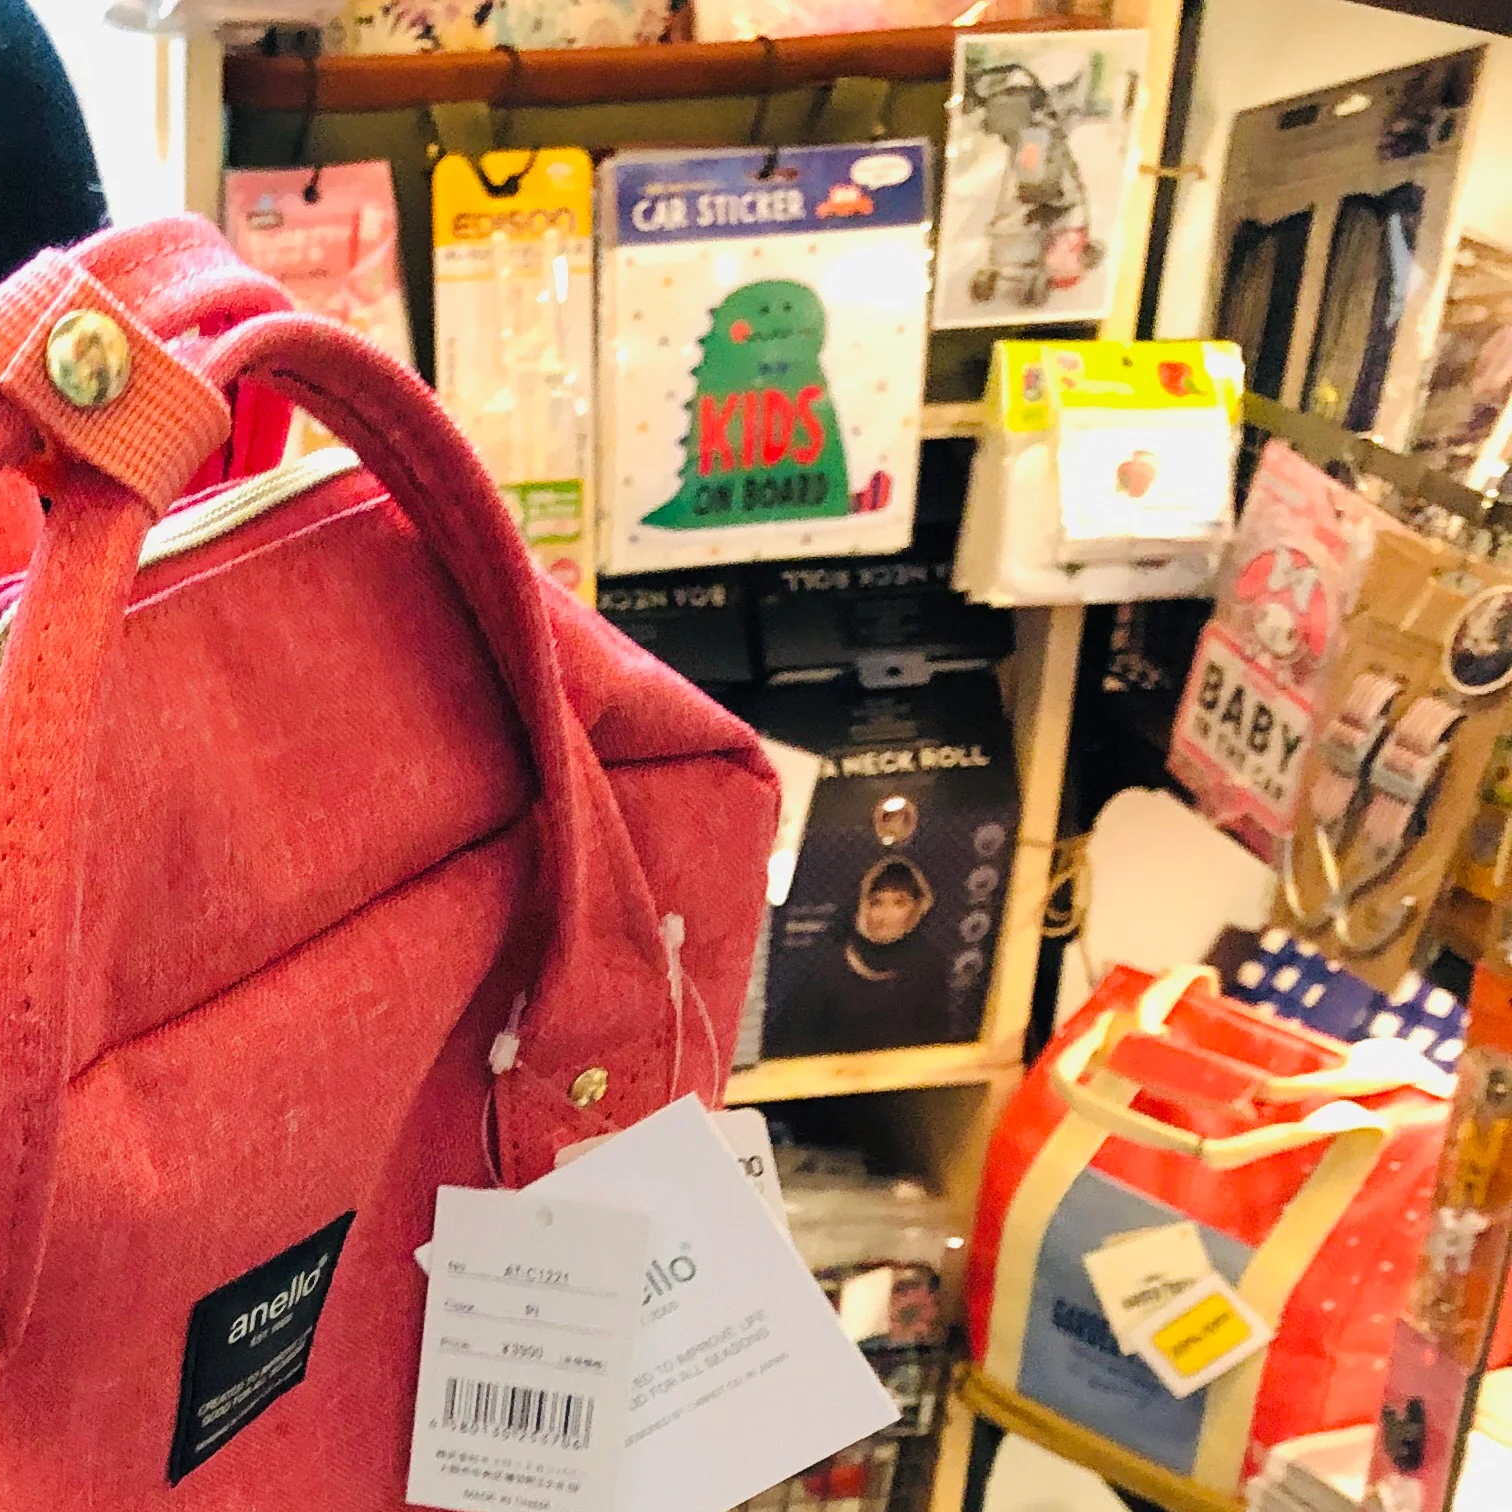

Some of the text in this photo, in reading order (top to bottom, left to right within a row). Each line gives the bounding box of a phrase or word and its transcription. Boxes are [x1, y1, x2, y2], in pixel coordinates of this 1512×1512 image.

[632, 188, 807, 232] CAR STICKER
[697, 384, 826, 477] KIDS
[692, 471, 828, 516] ON BOARD
[1199, 660, 1304, 774] BABY
[842, 749, 916, 778] NECK
[919, 745, 990, 771] ROLL
[228, 1268, 321, 1344] anello
